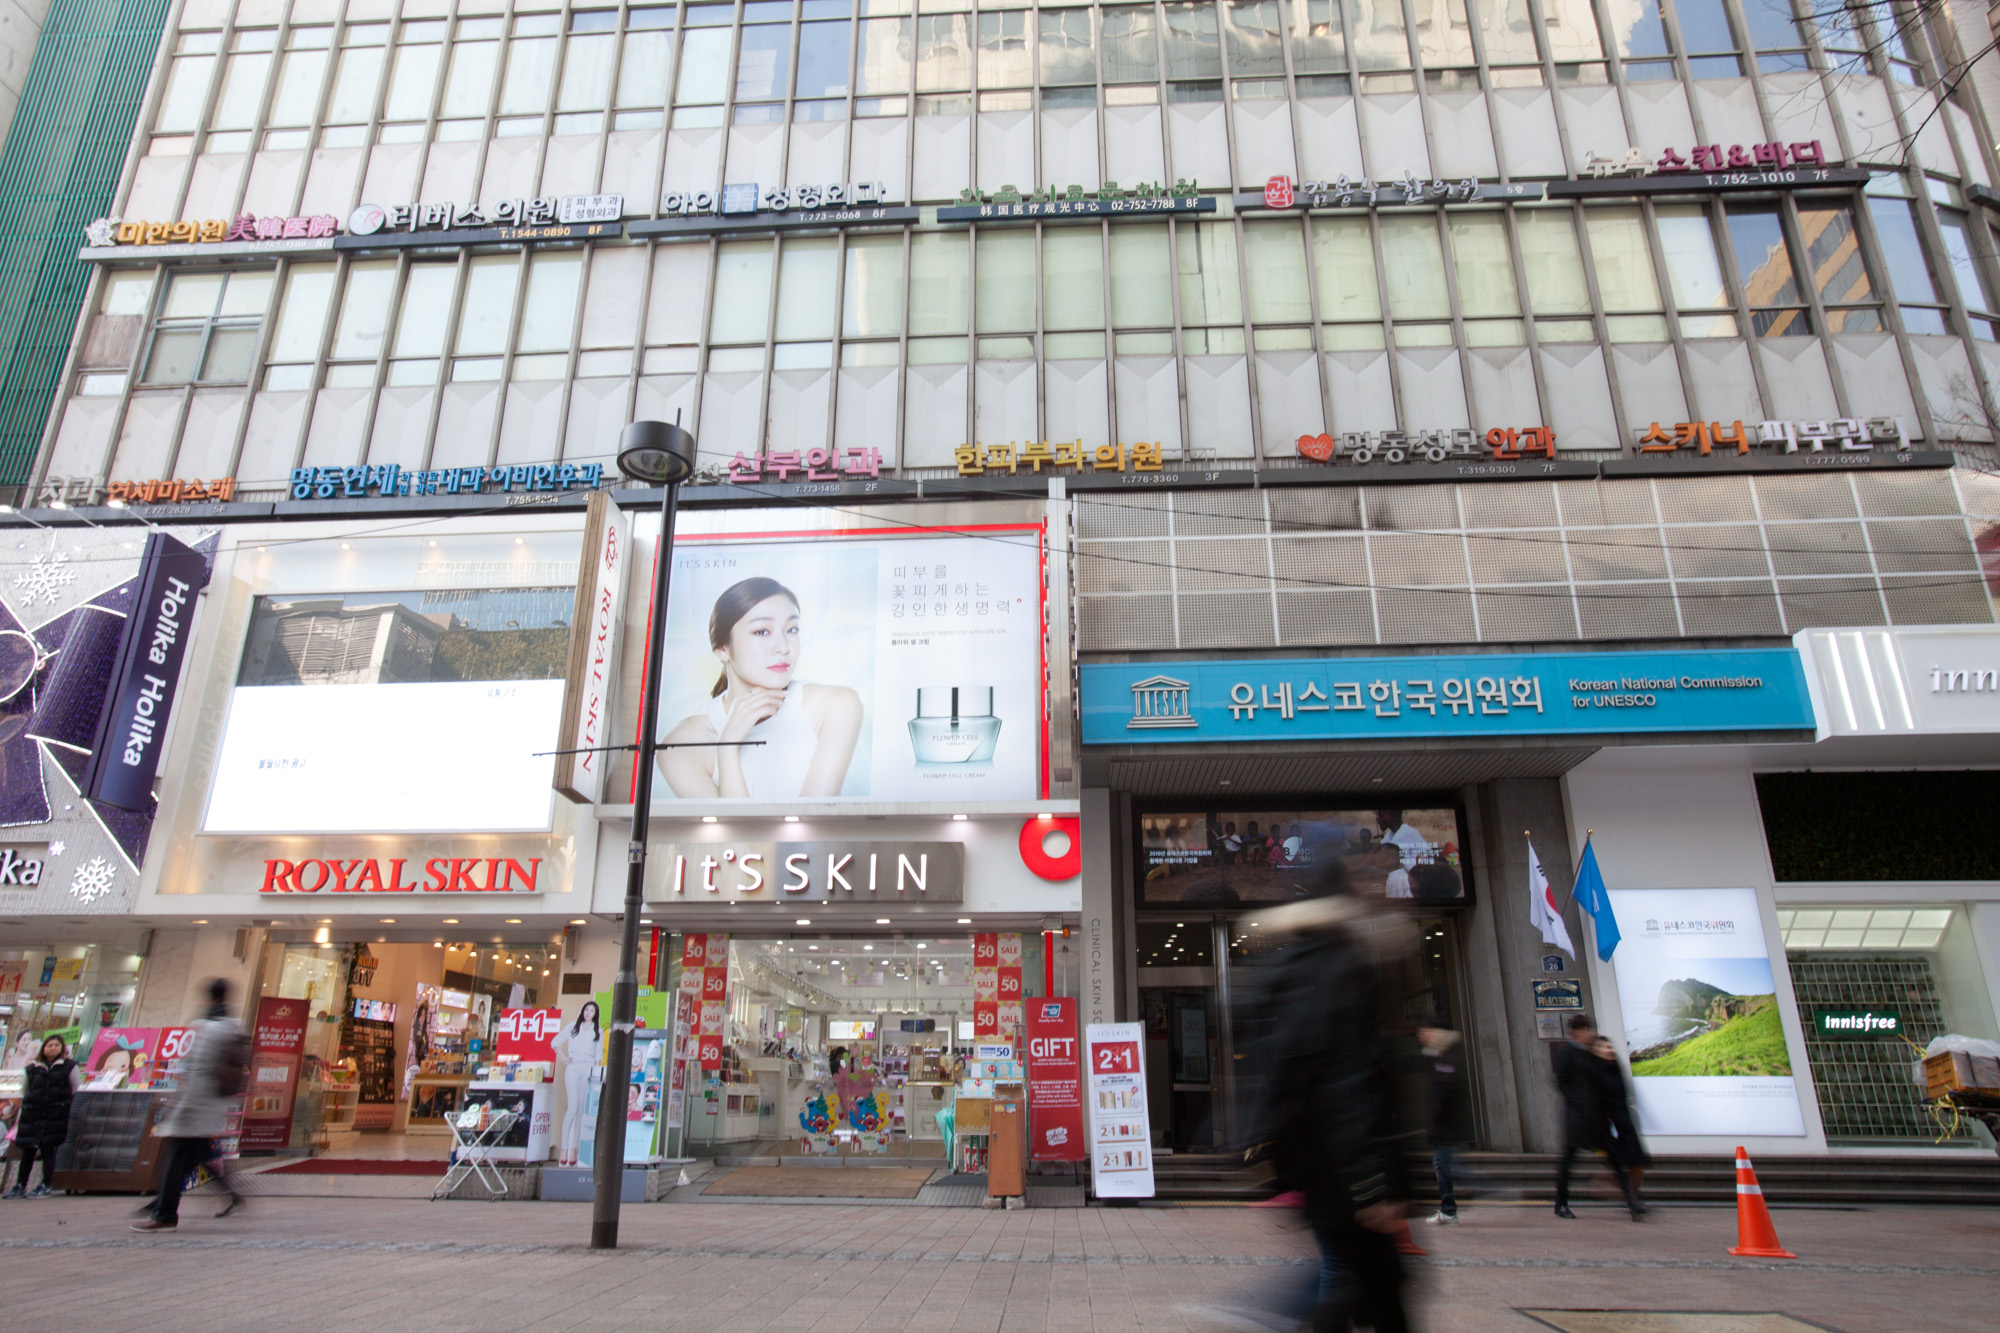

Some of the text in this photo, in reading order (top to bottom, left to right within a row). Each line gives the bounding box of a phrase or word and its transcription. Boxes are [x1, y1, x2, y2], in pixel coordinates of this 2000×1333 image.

[1656, 140, 1826, 174] 스킨&바디
[1721, 171, 1796, 185] 752-1010
[1812, 170, 1830, 181] 7F
[576, 195, 619, 207] 피부과
[663, 189, 721, 217] 하이
[764, 181, 887, 212] 성형외과
[575, 206, 618, 219] 성형외과
[980, 198, 1199, 217] 韩国医疗观光中心 02-752-7788 8F
[799, 208, 887, 223] T.773-6068 8F
[117, 219, 228, 246] 미한의원
[500, 225, 603, 239] T.1544-0890 8F
[1638, 416, 1911, 457] 스키니 피부관리
[1342, 426, 1557, 464] 명동성모 안과
[728, 446, 883, 484] 산부인과
[1897, 452, 1914, 464] 9F
[1541, 463, 1557, 473] 7F
[290, 463, 401, 499] 명동연세
[1205, 471, 1220, 482] 3F
[37, 474, 238, 505] 치과 연세미소래
[865, 482, 878, 492] 2F
[213, 505, 227, 515] 5F
[704, 557, 737, 568] SKIN
[892, 564, 949, 580] 피부를
[123, 576, 190, 767] Holika Holika
[582, 586, 613, 774] ROYAL SKIN
[1569, 674, 1763, 692] Korean National Commission
[1135, 689, 1189, 718] UNESCO
[1228, 675, 1544, 721] 유네스코한국위원회
[1572, 694, 1657, 708] for UNESCO
[0, 848, 43, 885] ka
[783, 853, 929, 893] SKIN
[258, 858, 544, 893] ROYAL SKIN
[1663, 920, 1735, 931] 유네스코한국위원회
[686, 945, 703, 958] 50
[708, 947, 726, 955] SALE
[977, 945, 995, 958] 50
[1000, 946, 1018, 954] SALE
[1090, 918, 1102, 976] CLINICAL
[1548, 963, 1559, 971] 26
[683, 980, 701, 988] SALE
[705, 978, 724, 992] 50
[977, 981, 995, 989] SALE
[1000, 978, 1019, 992] 50
[1091, 978, 1102, 1008] SKIN
[509, 1009, 547, 1041] 1+1
[976, 1013, 995, 1027] 50
[1000, 1015, 1018, 1023] SALE
[1825, 1012, 1897, 1032] innisfree
[701, 1047, 719, 1060] 50
[996, 1047, 1010, 1057] 50
[1030, 1037, 1075, 1058] GIFT
[1099, 1047, 1133, 1070] 2+1
[535, 1112, 550, 1123] OPEN
[532, 1124, 550, 1135] EVENT
